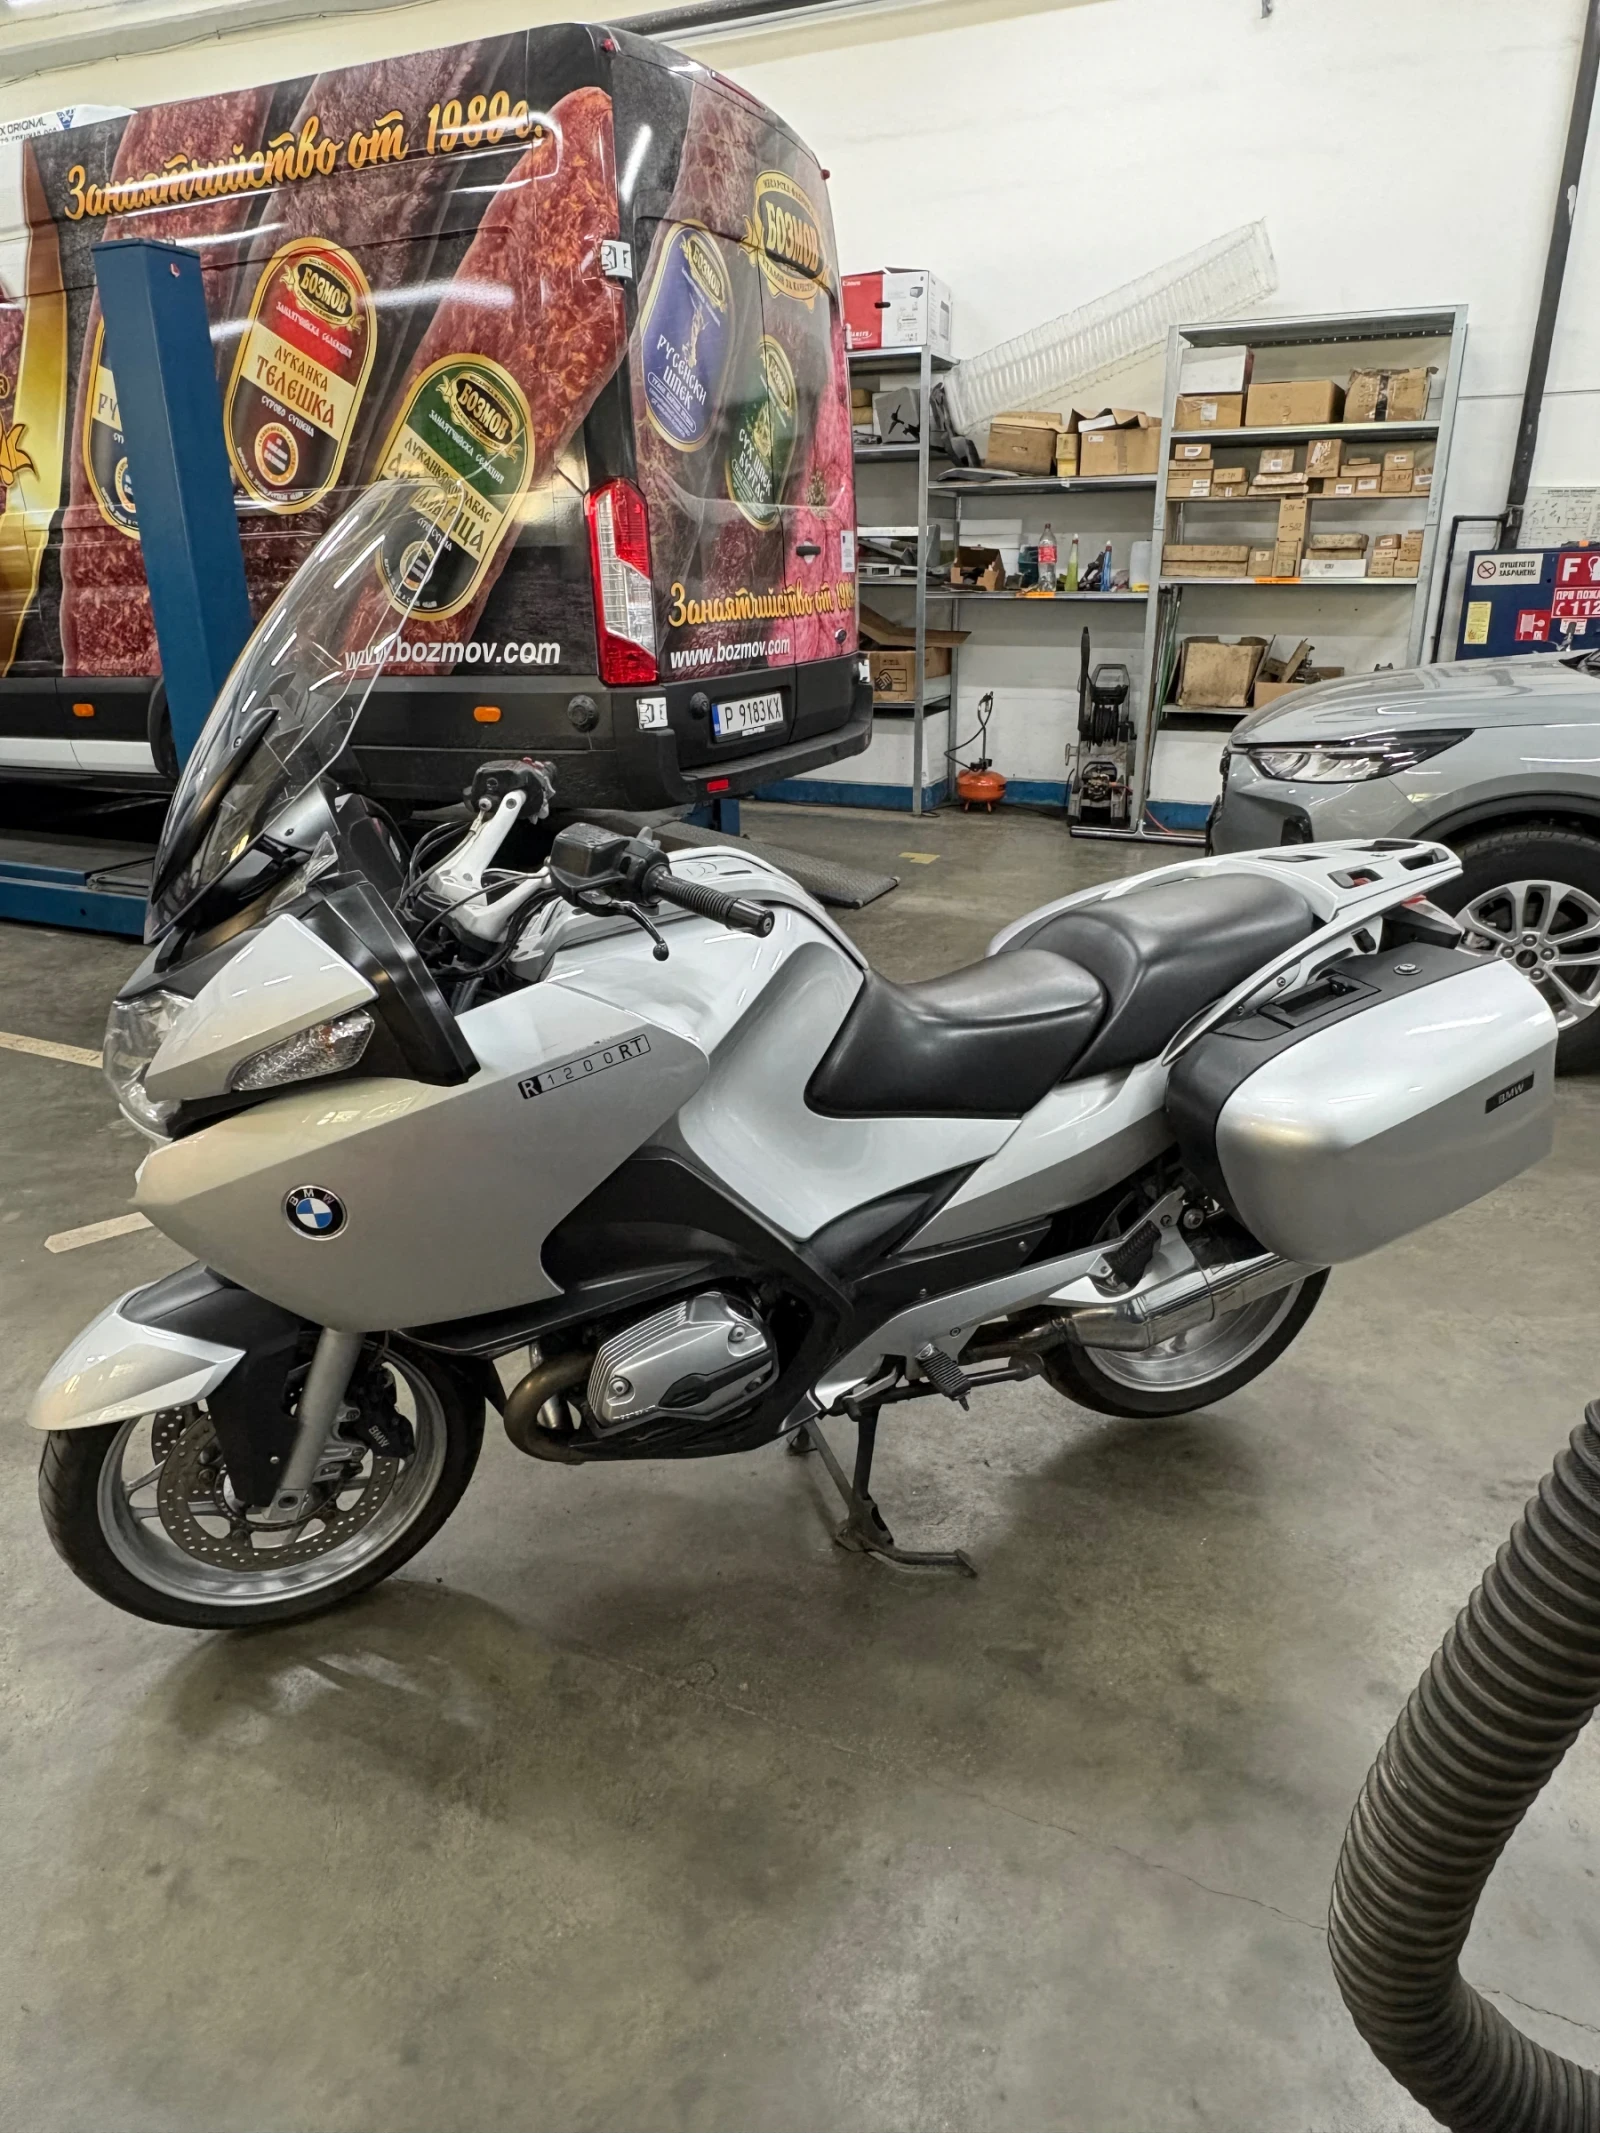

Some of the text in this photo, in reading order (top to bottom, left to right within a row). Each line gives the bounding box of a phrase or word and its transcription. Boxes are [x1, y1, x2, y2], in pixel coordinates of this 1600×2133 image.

[348, 110, 409, 169] от
[765, 200, 820, 272] БОЗМОВ
[300, 266, 349, 314] БОЗМОВ
[691, 243, 721, 297] БОЗМОВ
[257, 355, 335, 429] ТЕЛЕШКА
[274, 345, 328, 392] ЛУКАНКА
[657, 334, 706, 406] РУСЕНСКИ
[662, 366, 693, 410] ШПЕК
[458, 383, 510, 440] БОЗМОВ
[739, 429, 754, 460] СУХ
[754, 455, 772, 496] ШПЕК
[739, 451, 765, 503] БУРГАС
[1499, 561, 1536, 569] ПУШЕНЕТО
[1562, 558, 1582, 581] F
[668, 577, 813, 627] Занаятчийство
[815, 583, 834, 614] от
[1556, 591, 1574, 600] ПРИ
[345, 636, 560, 671] www.bozmov.com
[671, 638, 790, 668] www.bozmov.com
[1499, 1081, 1524, 1104] BMW
[289, 1189, 335, 1206] BMW
[369, 1425, 390, 1447] BMW
